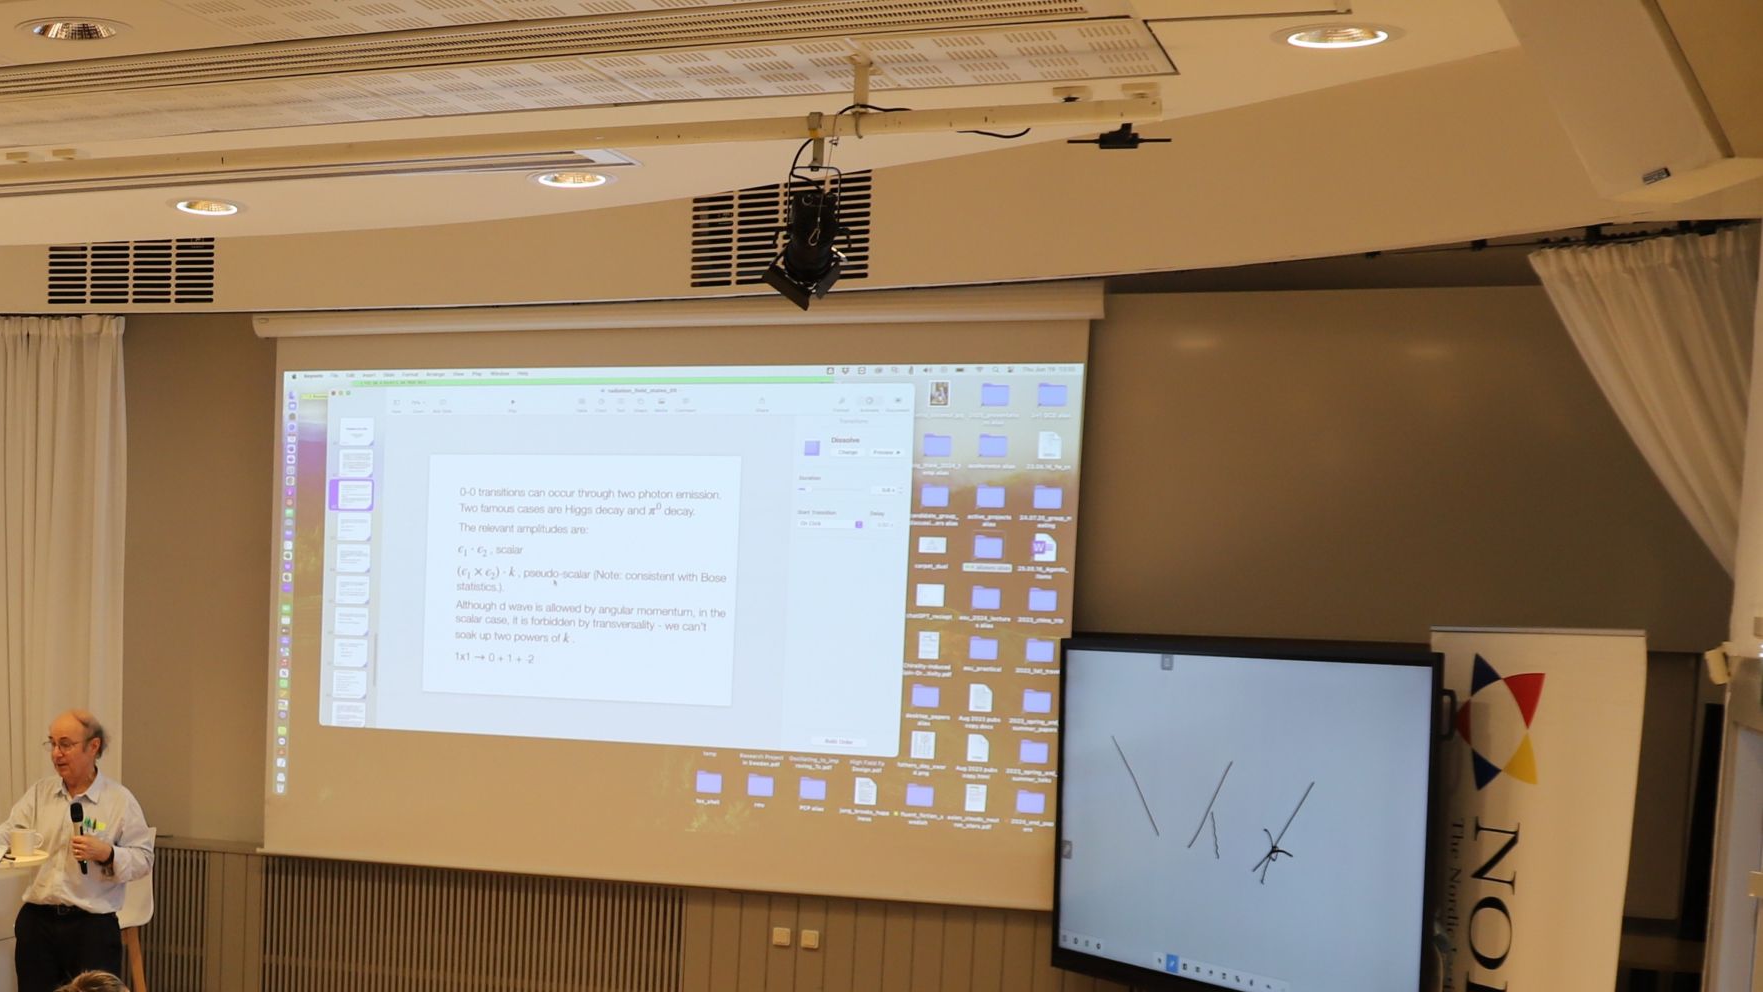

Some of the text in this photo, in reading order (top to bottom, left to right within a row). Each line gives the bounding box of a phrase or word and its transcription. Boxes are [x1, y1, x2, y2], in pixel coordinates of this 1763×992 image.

[459, 487, 722, 501] 0-0 transitions can occur through two photon emission.
[459, 502, 478, 513] Two
[480, 503, 515, 514] famous
[517, 505, 545, 514] cases
[547, 507, 563, 515] are
[565, 504, 593, 517] Higgs
[595, 506, 625, 517] decay
[627, 506, 646, 516] and
[664, 506, 695, 518] decay.
[459, 522, 476, 533] The
[478, 523, 514, 534] relevant
[517, 524, 570, 536] amplitudes
[496, 545, 524, 555] scalar
[523, 568, 591, 579] pseudo-scalar
[593, 569, 623, 581] (Note:
[625, 571, 675, 581] consistent
[678, 572, 698, 582] with
[701, 572, 727, 583] Bose
[456, 600, 727, 618] Although d wave is allowed by angular momentum, in the
[455, 614, 707, 632] scalar case, it is forbidden by transversality we can't
[455, 631, 477, 640] soak
[479, 632, 491, 642] up
[494, 632, 512, 641] two
[514, 634, 549, 643] powers
[551, 633, 561, 643] of
[1450, 817, 1465, 861] The
[1445, 867, 1462, 935] Nordic
